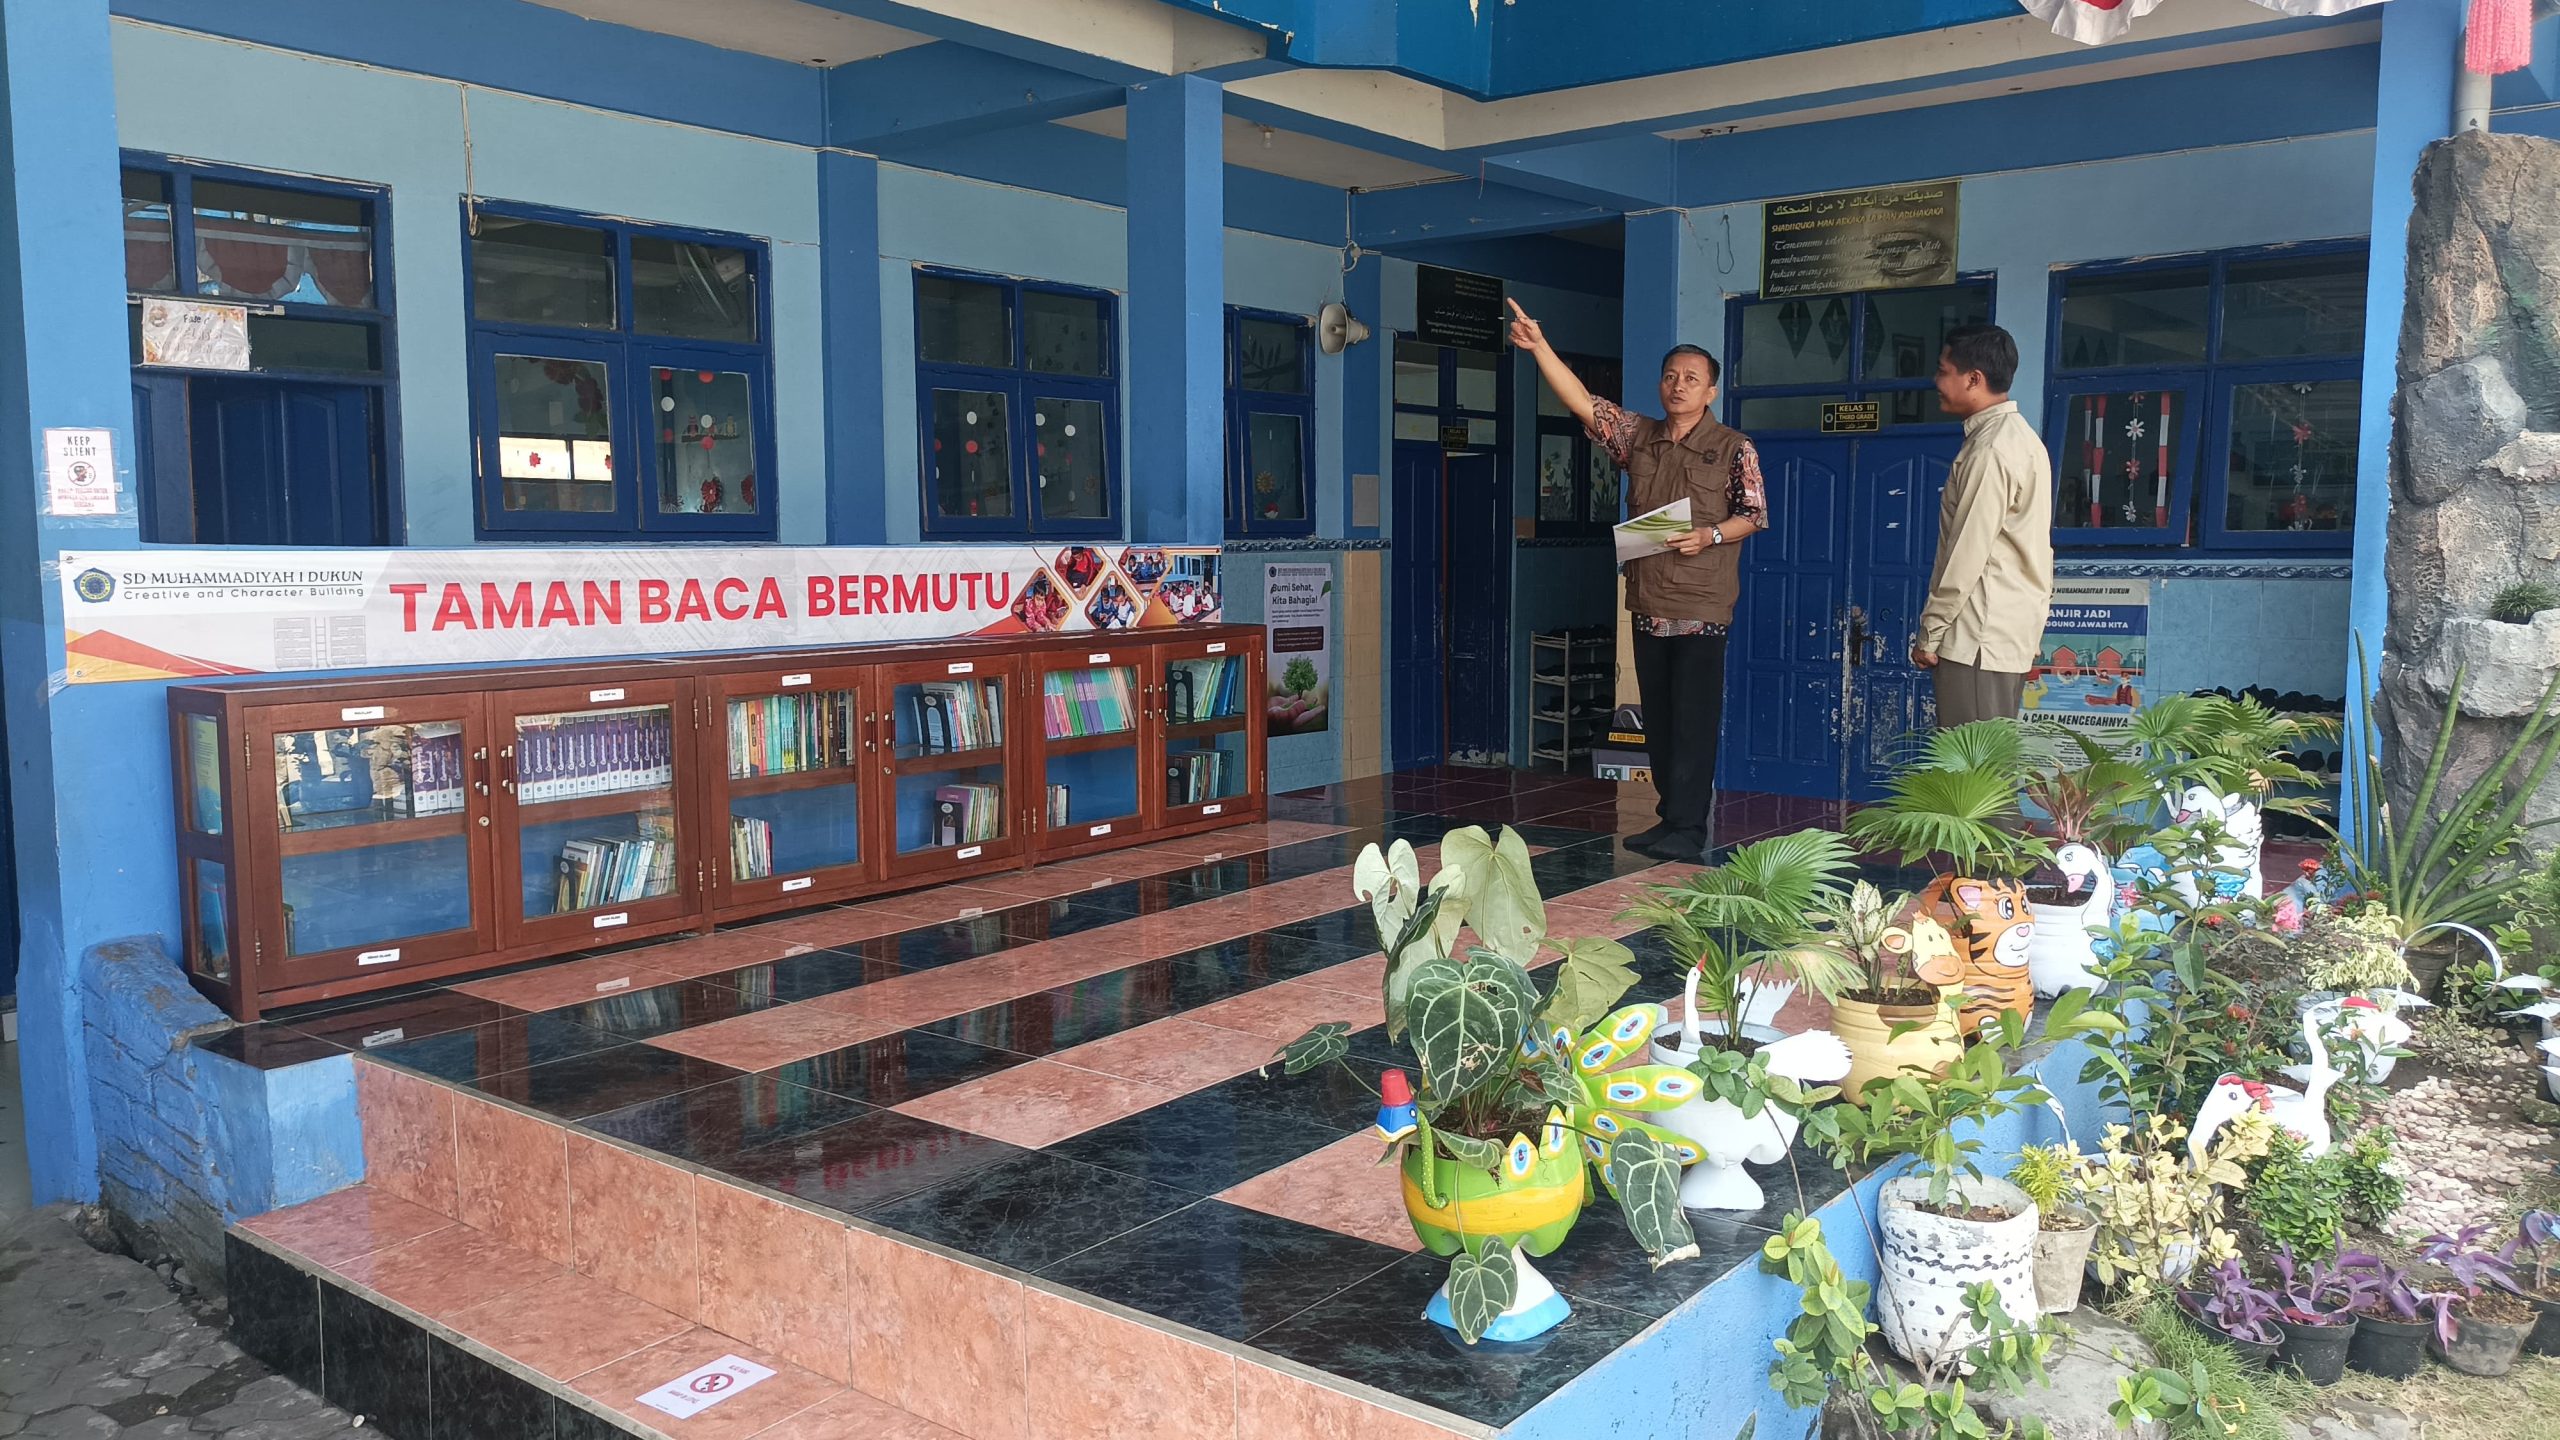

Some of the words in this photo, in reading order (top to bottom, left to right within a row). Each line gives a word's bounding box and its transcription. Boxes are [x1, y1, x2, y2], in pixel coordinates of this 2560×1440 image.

[1837, 199, 1846, 210] لا
[1881, 191, 1899, 207] من
[1816, 203, 1833, 214] من
[1816, 219, 1835, 228] MAN
[67, 435, 91, 446] KEEP
[123, 572, 146, 585] SD
[151, 570, 295, 584] MUHAMMADIYAH
[308, 570, 363, 583] DUKUN
[124, 590, 190, 600] Creative
[197, 588, 224, 599] and
[231, 587, 303, 598] Character
[310, 586, 364, 597] Building
[1270, 583, 1291, 594] Bumi
[1291, 583, 1314, 593] Sehat,
[389, 579, 622, 632] TAMAN
[638, 576, 788, 624] BACA
[807, 571, 1009, 617] BERMUTU
[1272, 595, 1287, 605] Kita
[1288, 595, 1318, 606] Bahagia!
[2049, 608, 2081, 618] ANJIR
[2083, 609, 2111, 619] JADI
[2108, 621, 2128, 629] KITA
[2022, 713, 2028, 722] 4
[2031, 713, 2055, 723] CARA
[2057, 714, 2128, 727] MENCEGAHNYA
[2134, 746, 2142, 756] 2
